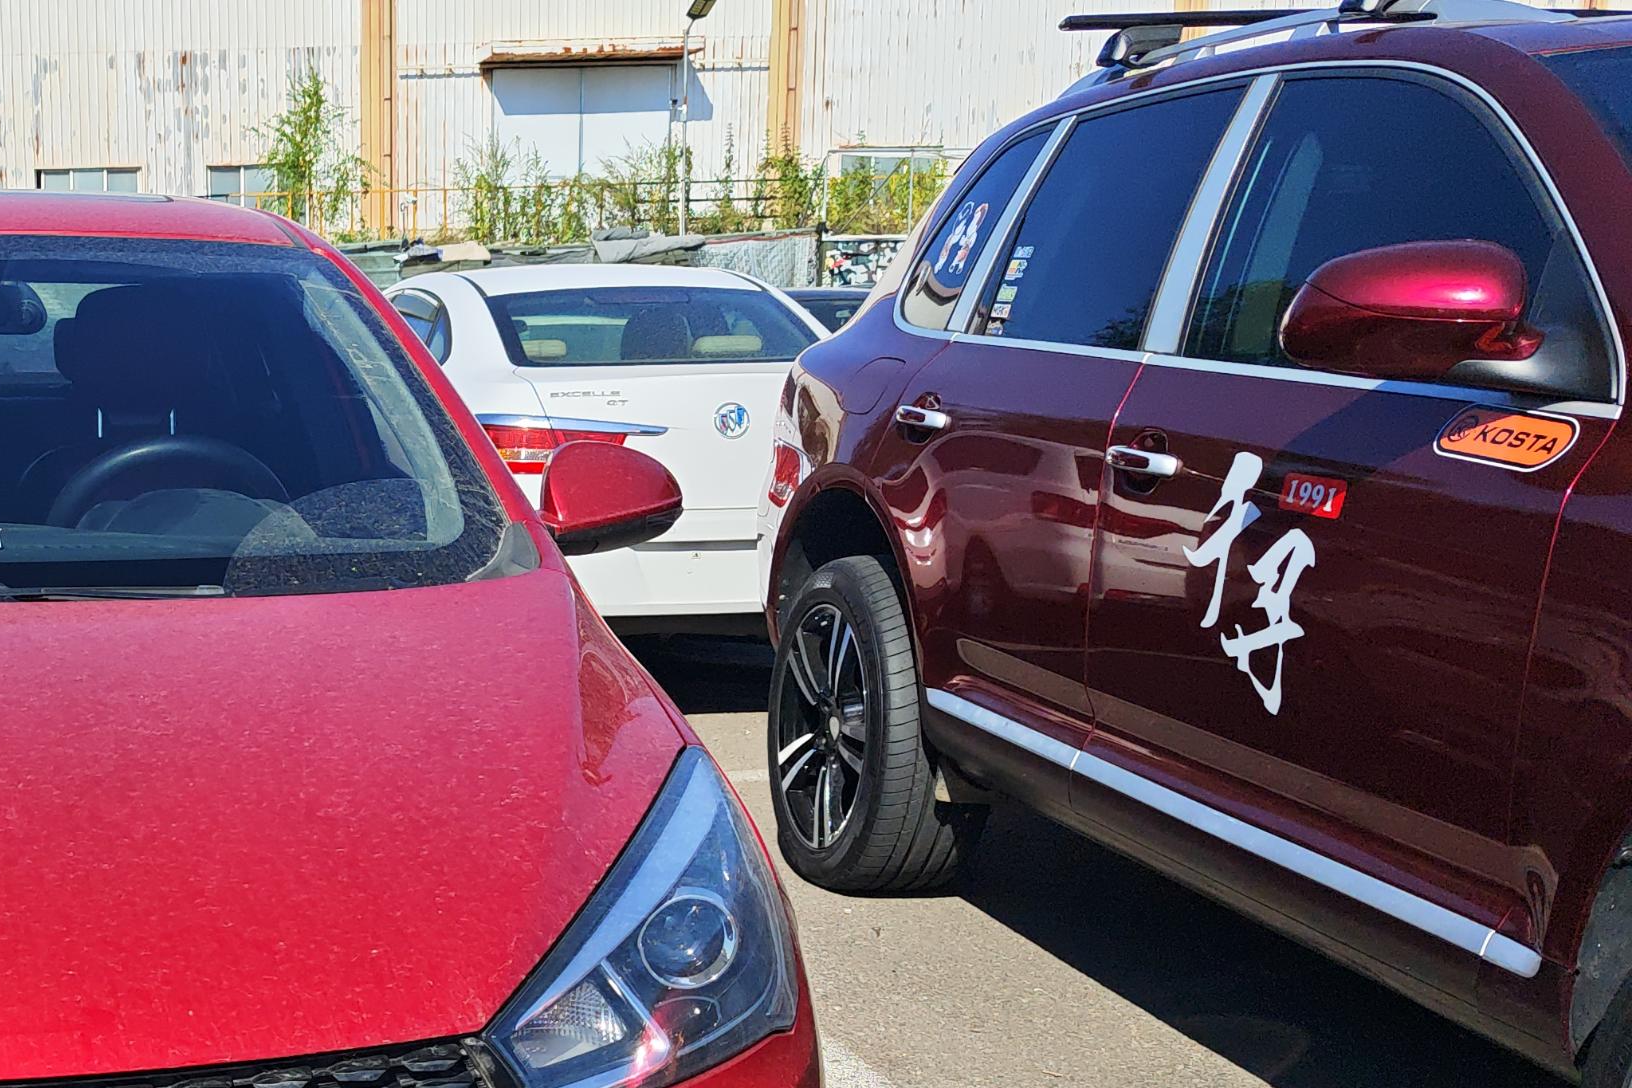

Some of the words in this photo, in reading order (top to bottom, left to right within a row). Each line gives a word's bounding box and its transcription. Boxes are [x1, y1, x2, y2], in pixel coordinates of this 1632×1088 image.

[550, 390, 622, 398] EXCELLE
[1473, 425, 1559, 455] KOSTA
[1286, 479, 1338, 512] 1991
